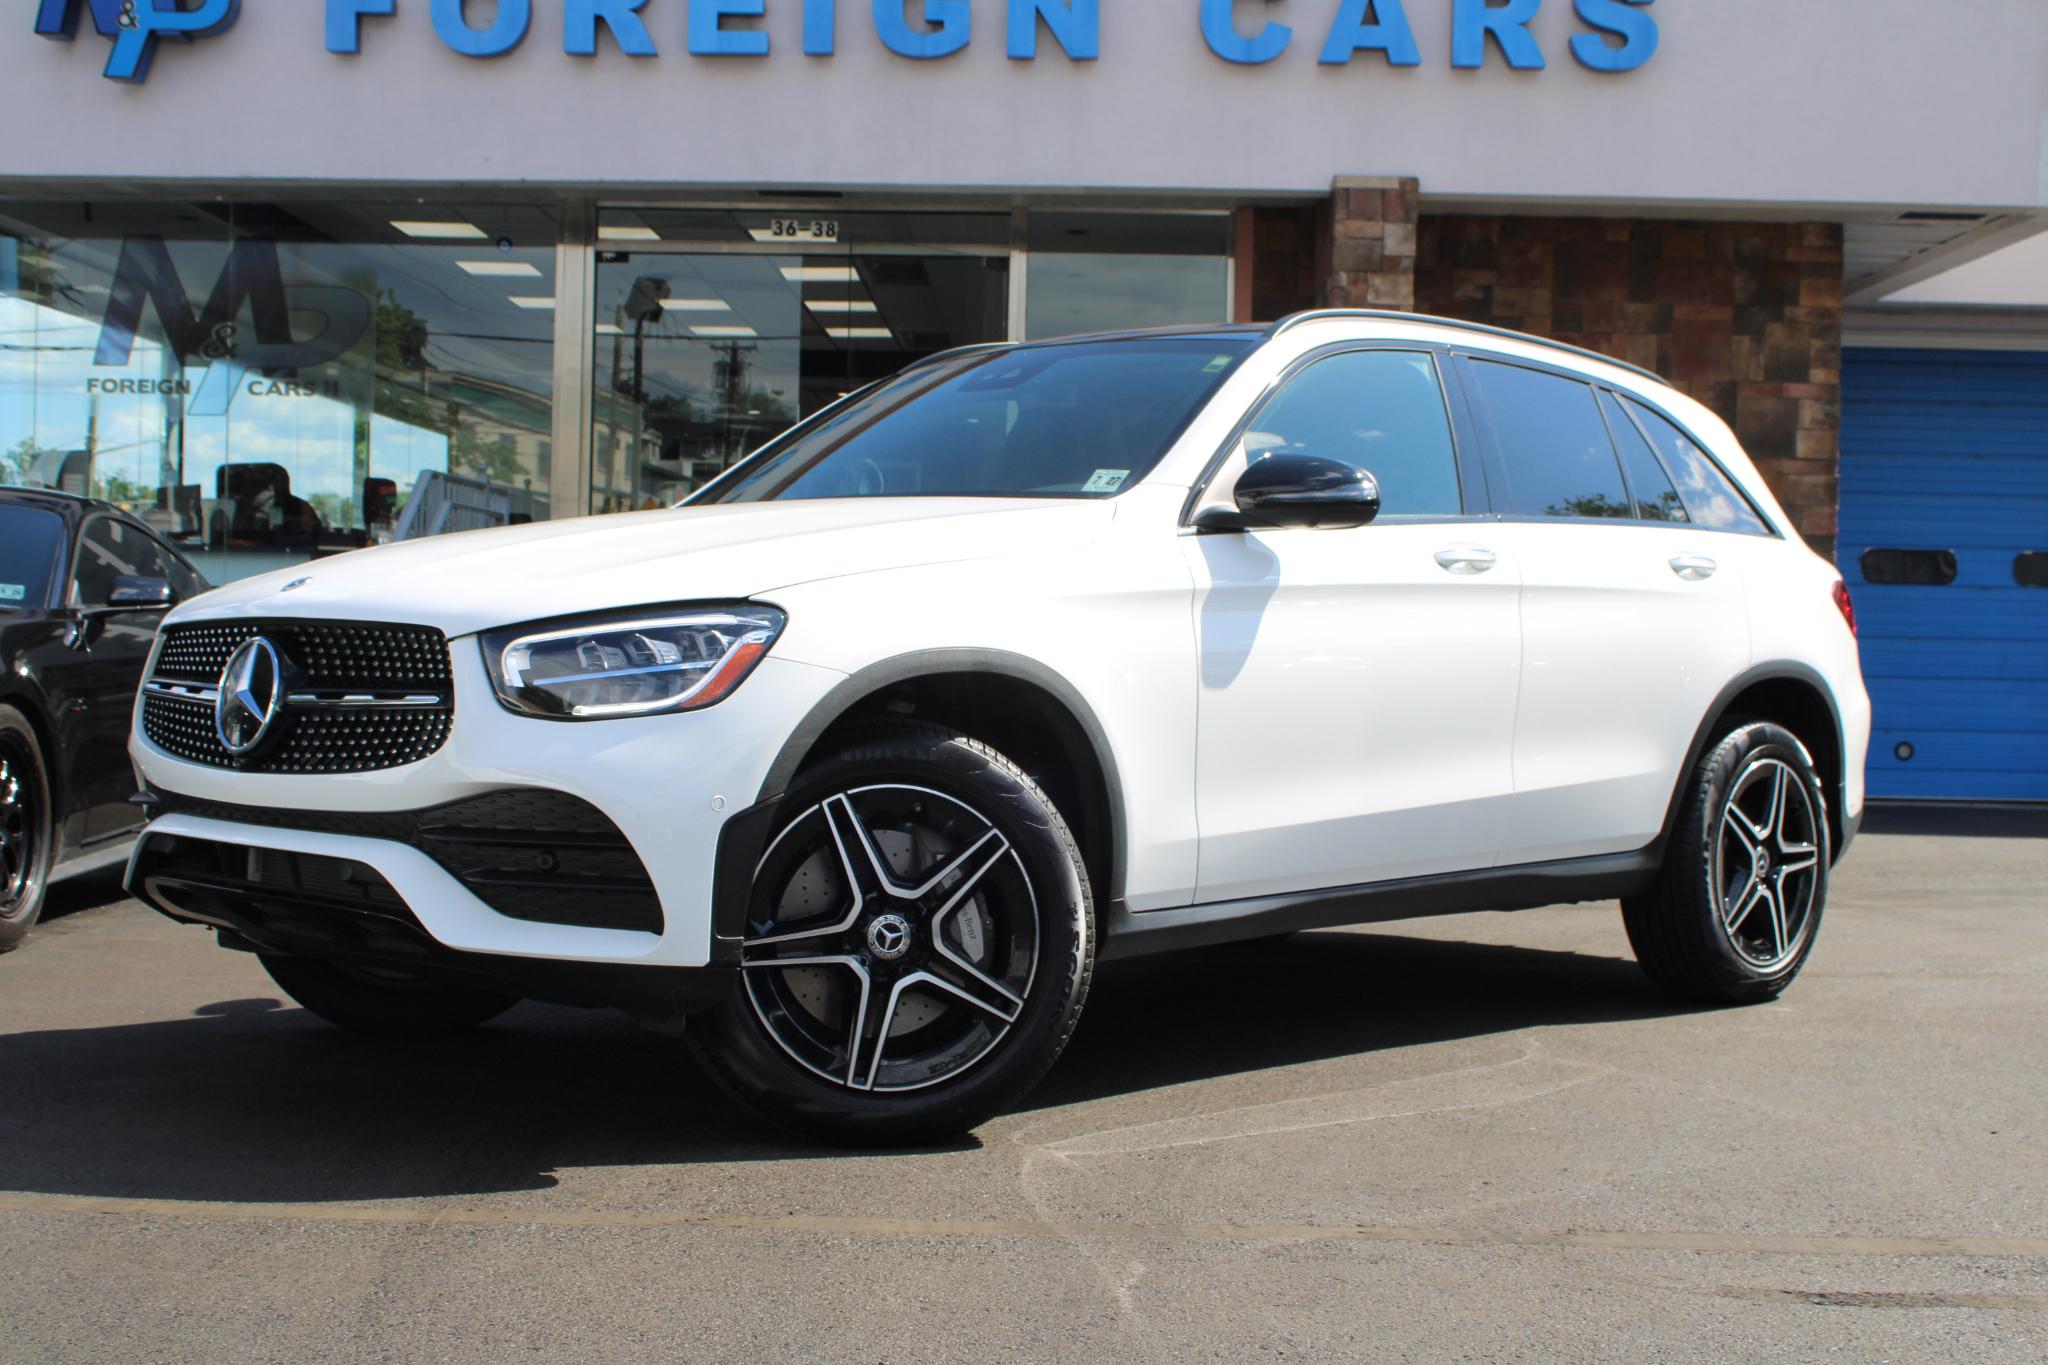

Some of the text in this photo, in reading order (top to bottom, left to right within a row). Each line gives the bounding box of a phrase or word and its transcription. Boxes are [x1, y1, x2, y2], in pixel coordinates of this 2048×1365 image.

[1200, 0, 1659, 72] CARS
[86, 378, 191, 395] FOREIGN
[247, 380, 317, 396] CARS
